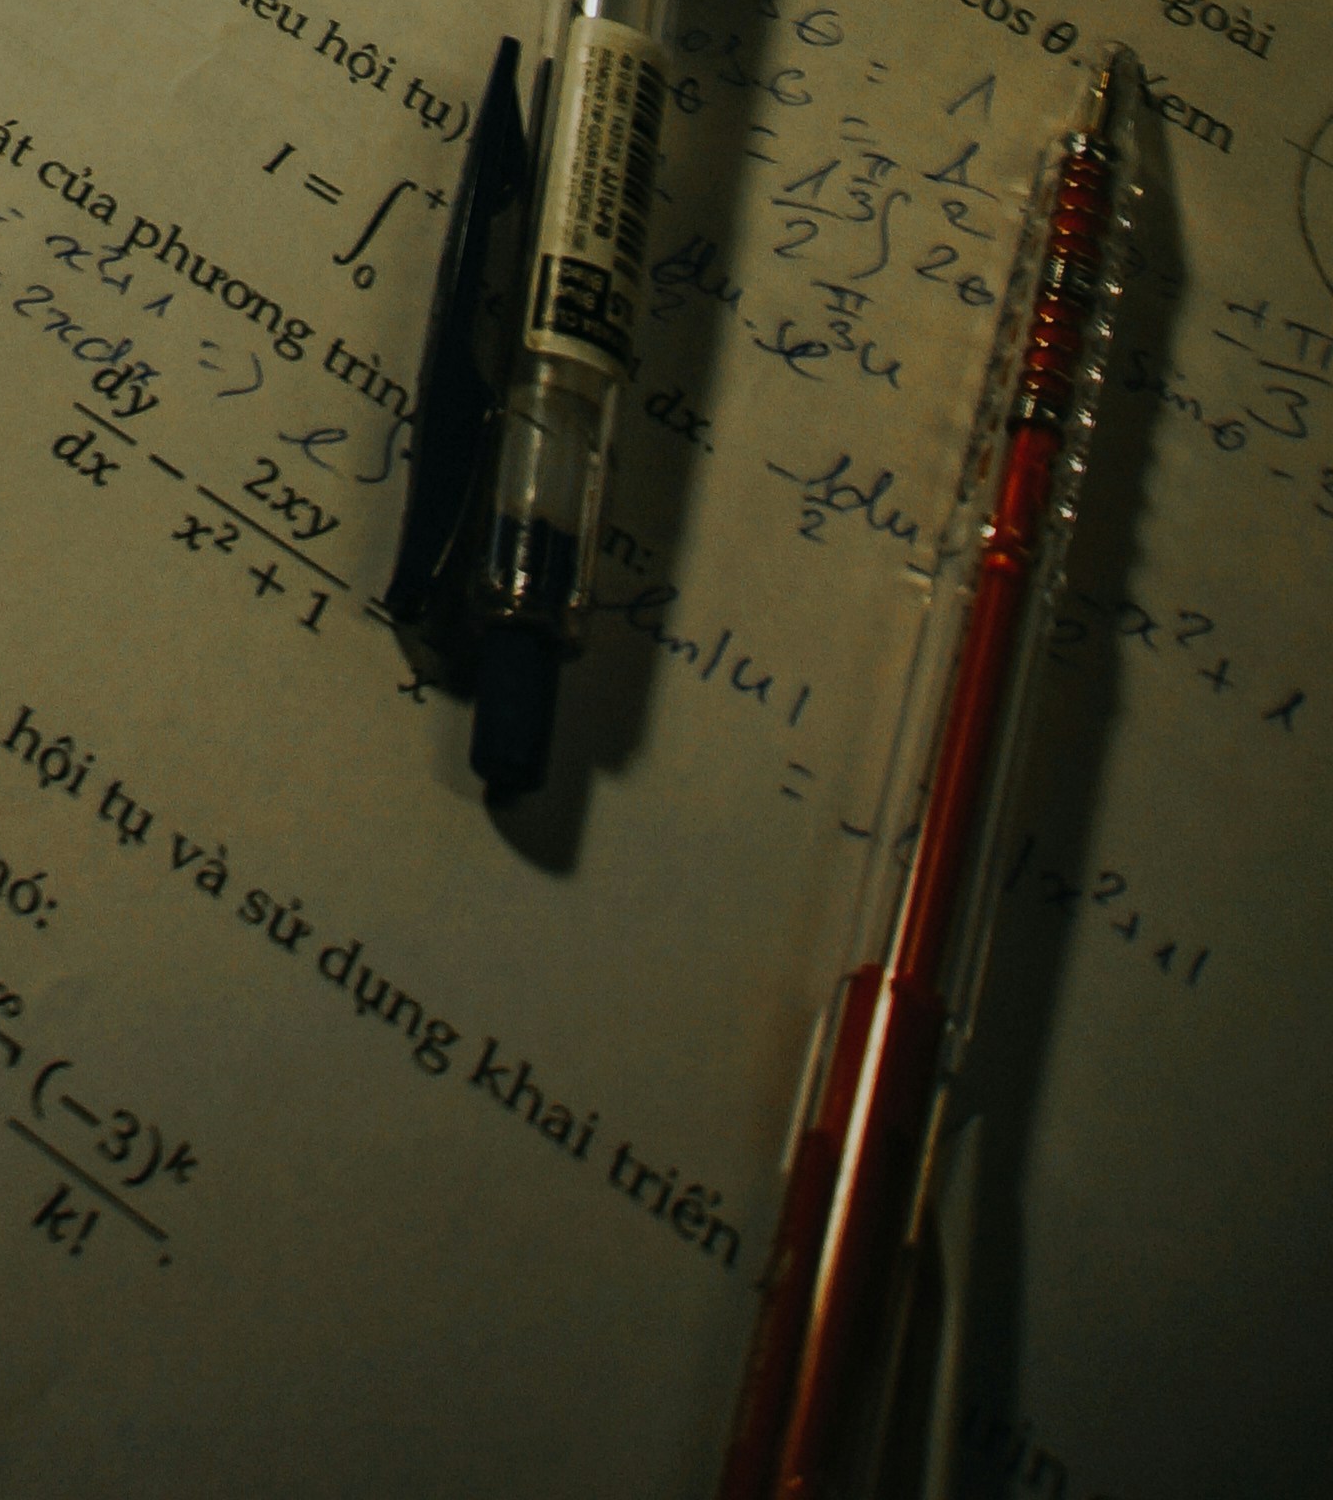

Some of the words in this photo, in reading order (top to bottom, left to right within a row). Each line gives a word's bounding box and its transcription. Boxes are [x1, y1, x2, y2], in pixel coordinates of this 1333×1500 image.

[312, 19, 399, 94] hội
[36, 152, 120, 226] của
[122, 212, 317, 364] phương
[1, 704, 97, 795] hội
[96, 778, 159, 848] tụ
[170, 831, 233, 899] và
[237, 886, 315, 955] sử
[315, 937, 462, 1078] dụng
[467, 1036, 603, 1163] khai
[605, 1138, 744, 1270] triển
